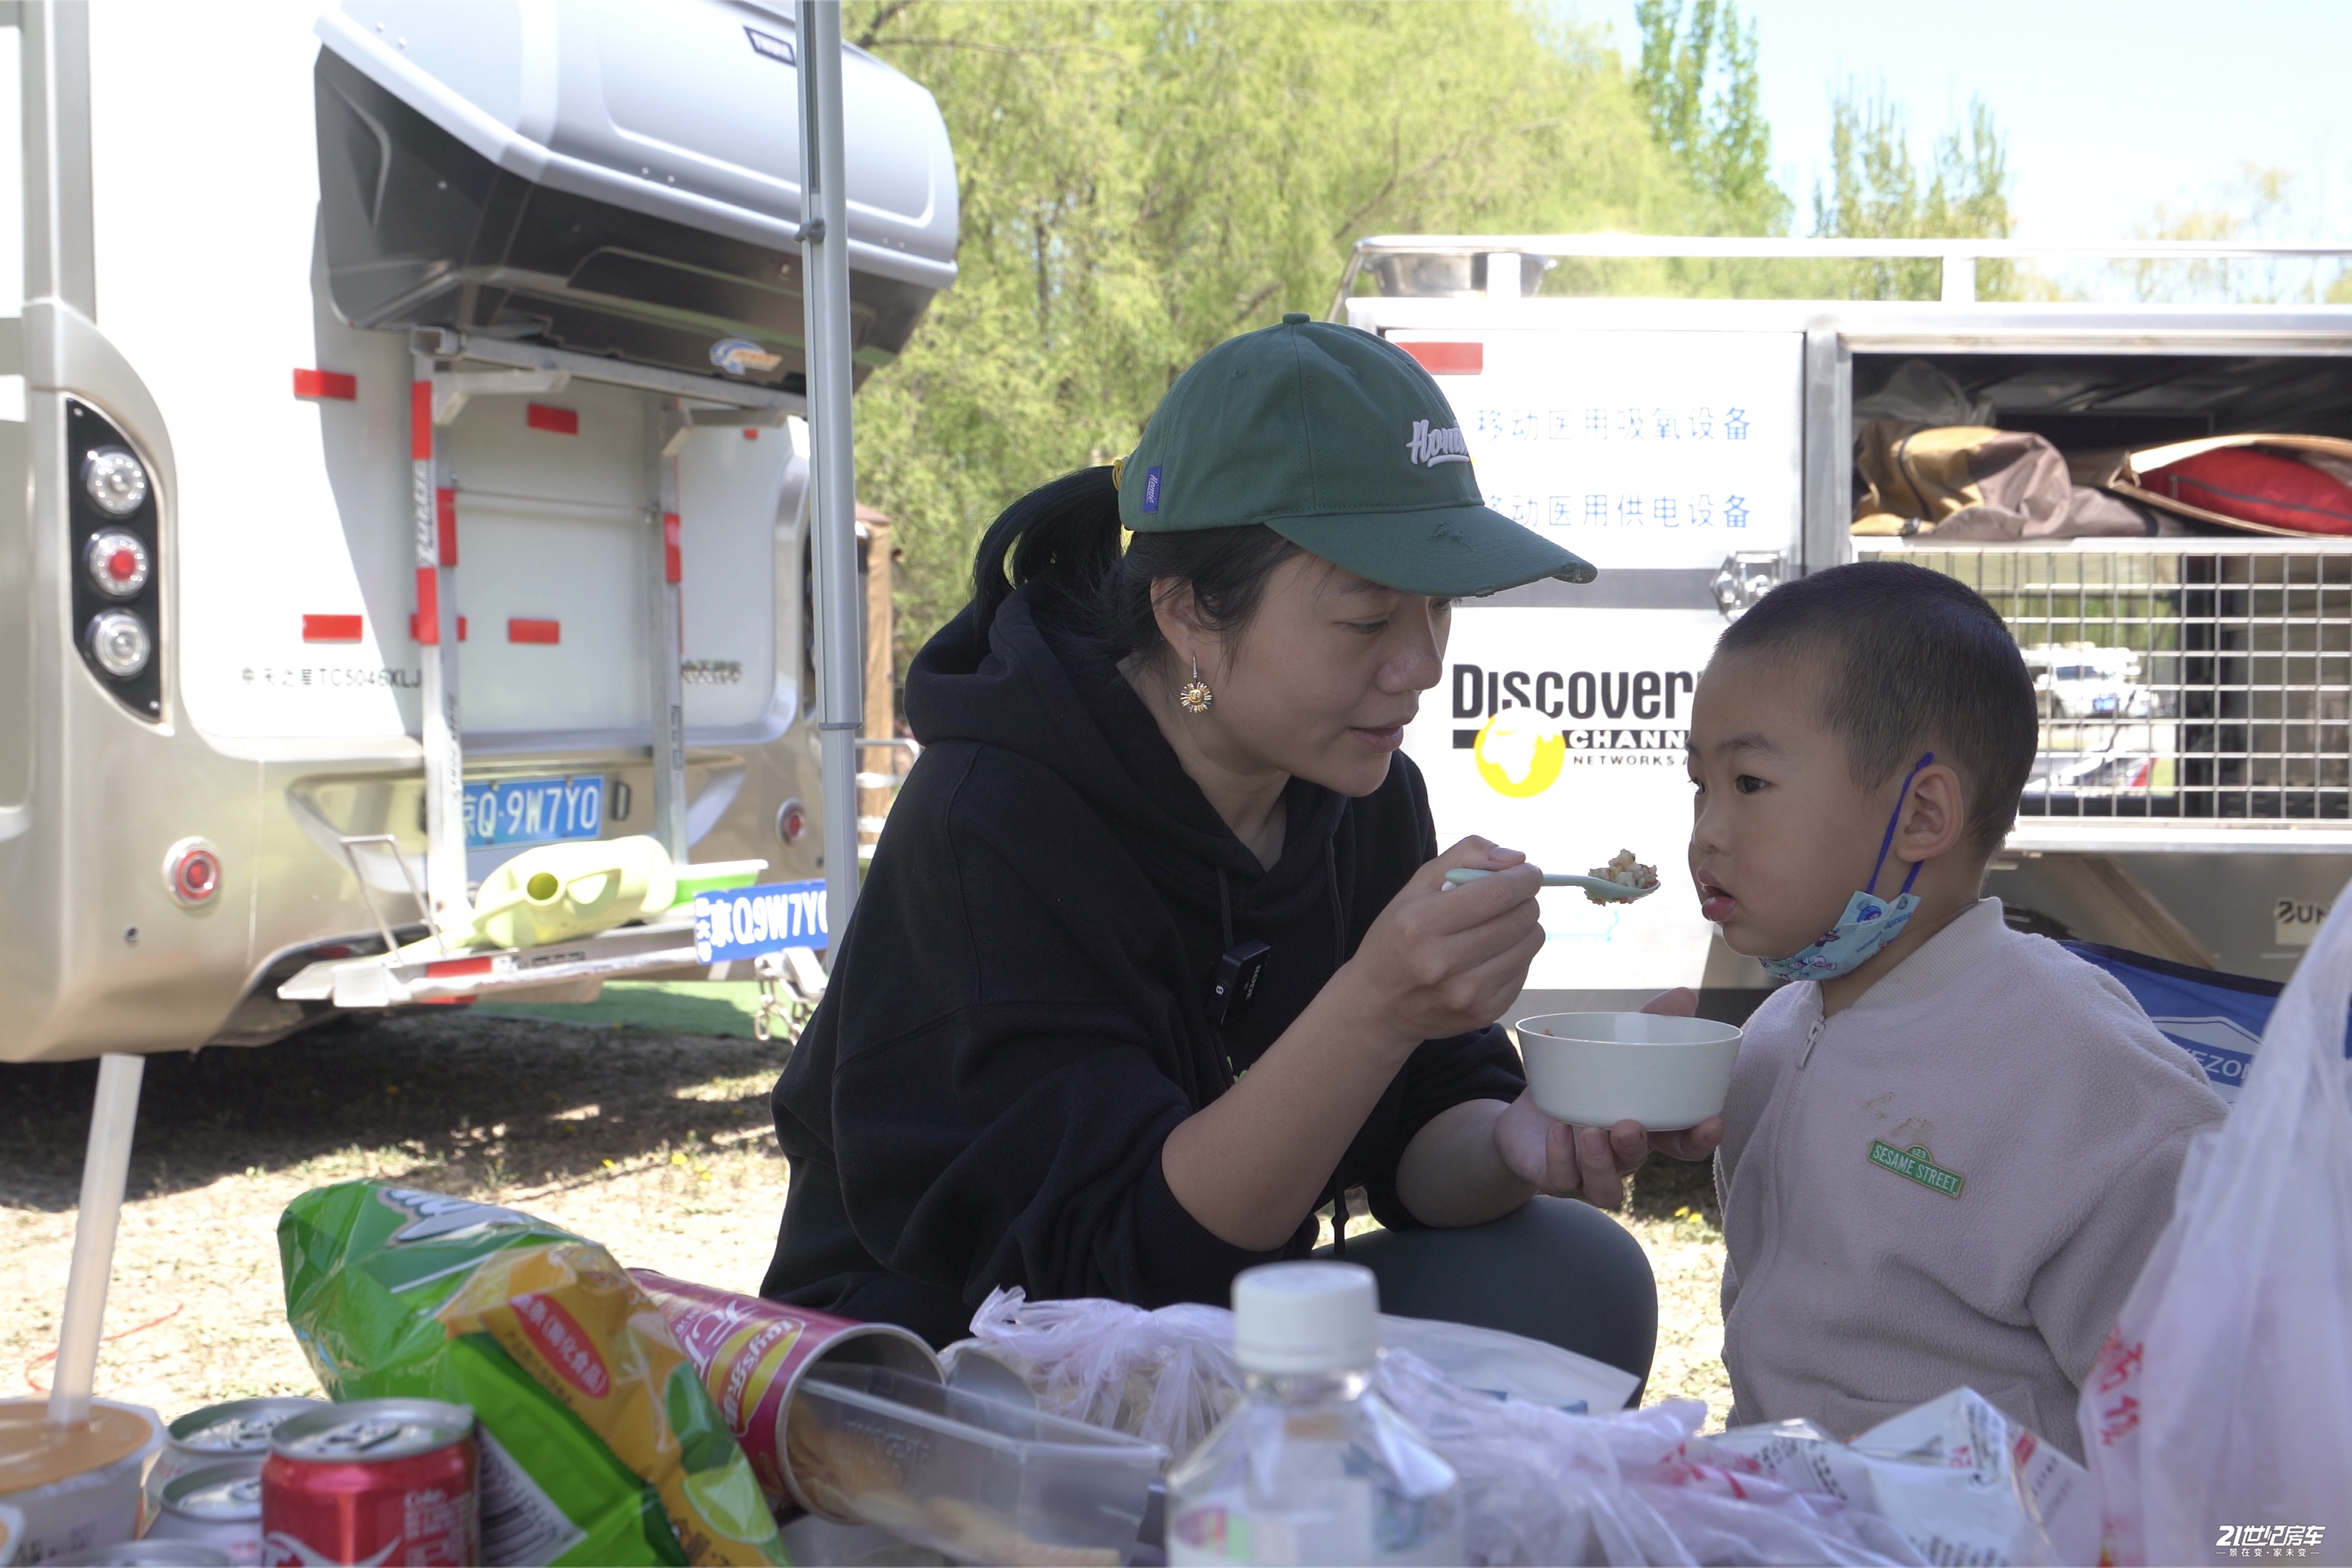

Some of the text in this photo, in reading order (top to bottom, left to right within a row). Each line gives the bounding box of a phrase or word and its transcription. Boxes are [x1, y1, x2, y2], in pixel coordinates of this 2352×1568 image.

[1477, 407, 1750, 441] 移动医用吸氧设备
[1147, 474, 1158, 504] Homie
[1453, 663, 1707, 719] Discover
[1569, 730, 1689, 748] CHANN
[1573, 756, 1675, 766] NETWORKS
[1912, 1148, 1927, 1159] 123
[1873, 1145, 1959, 1193] SESAME STREET
